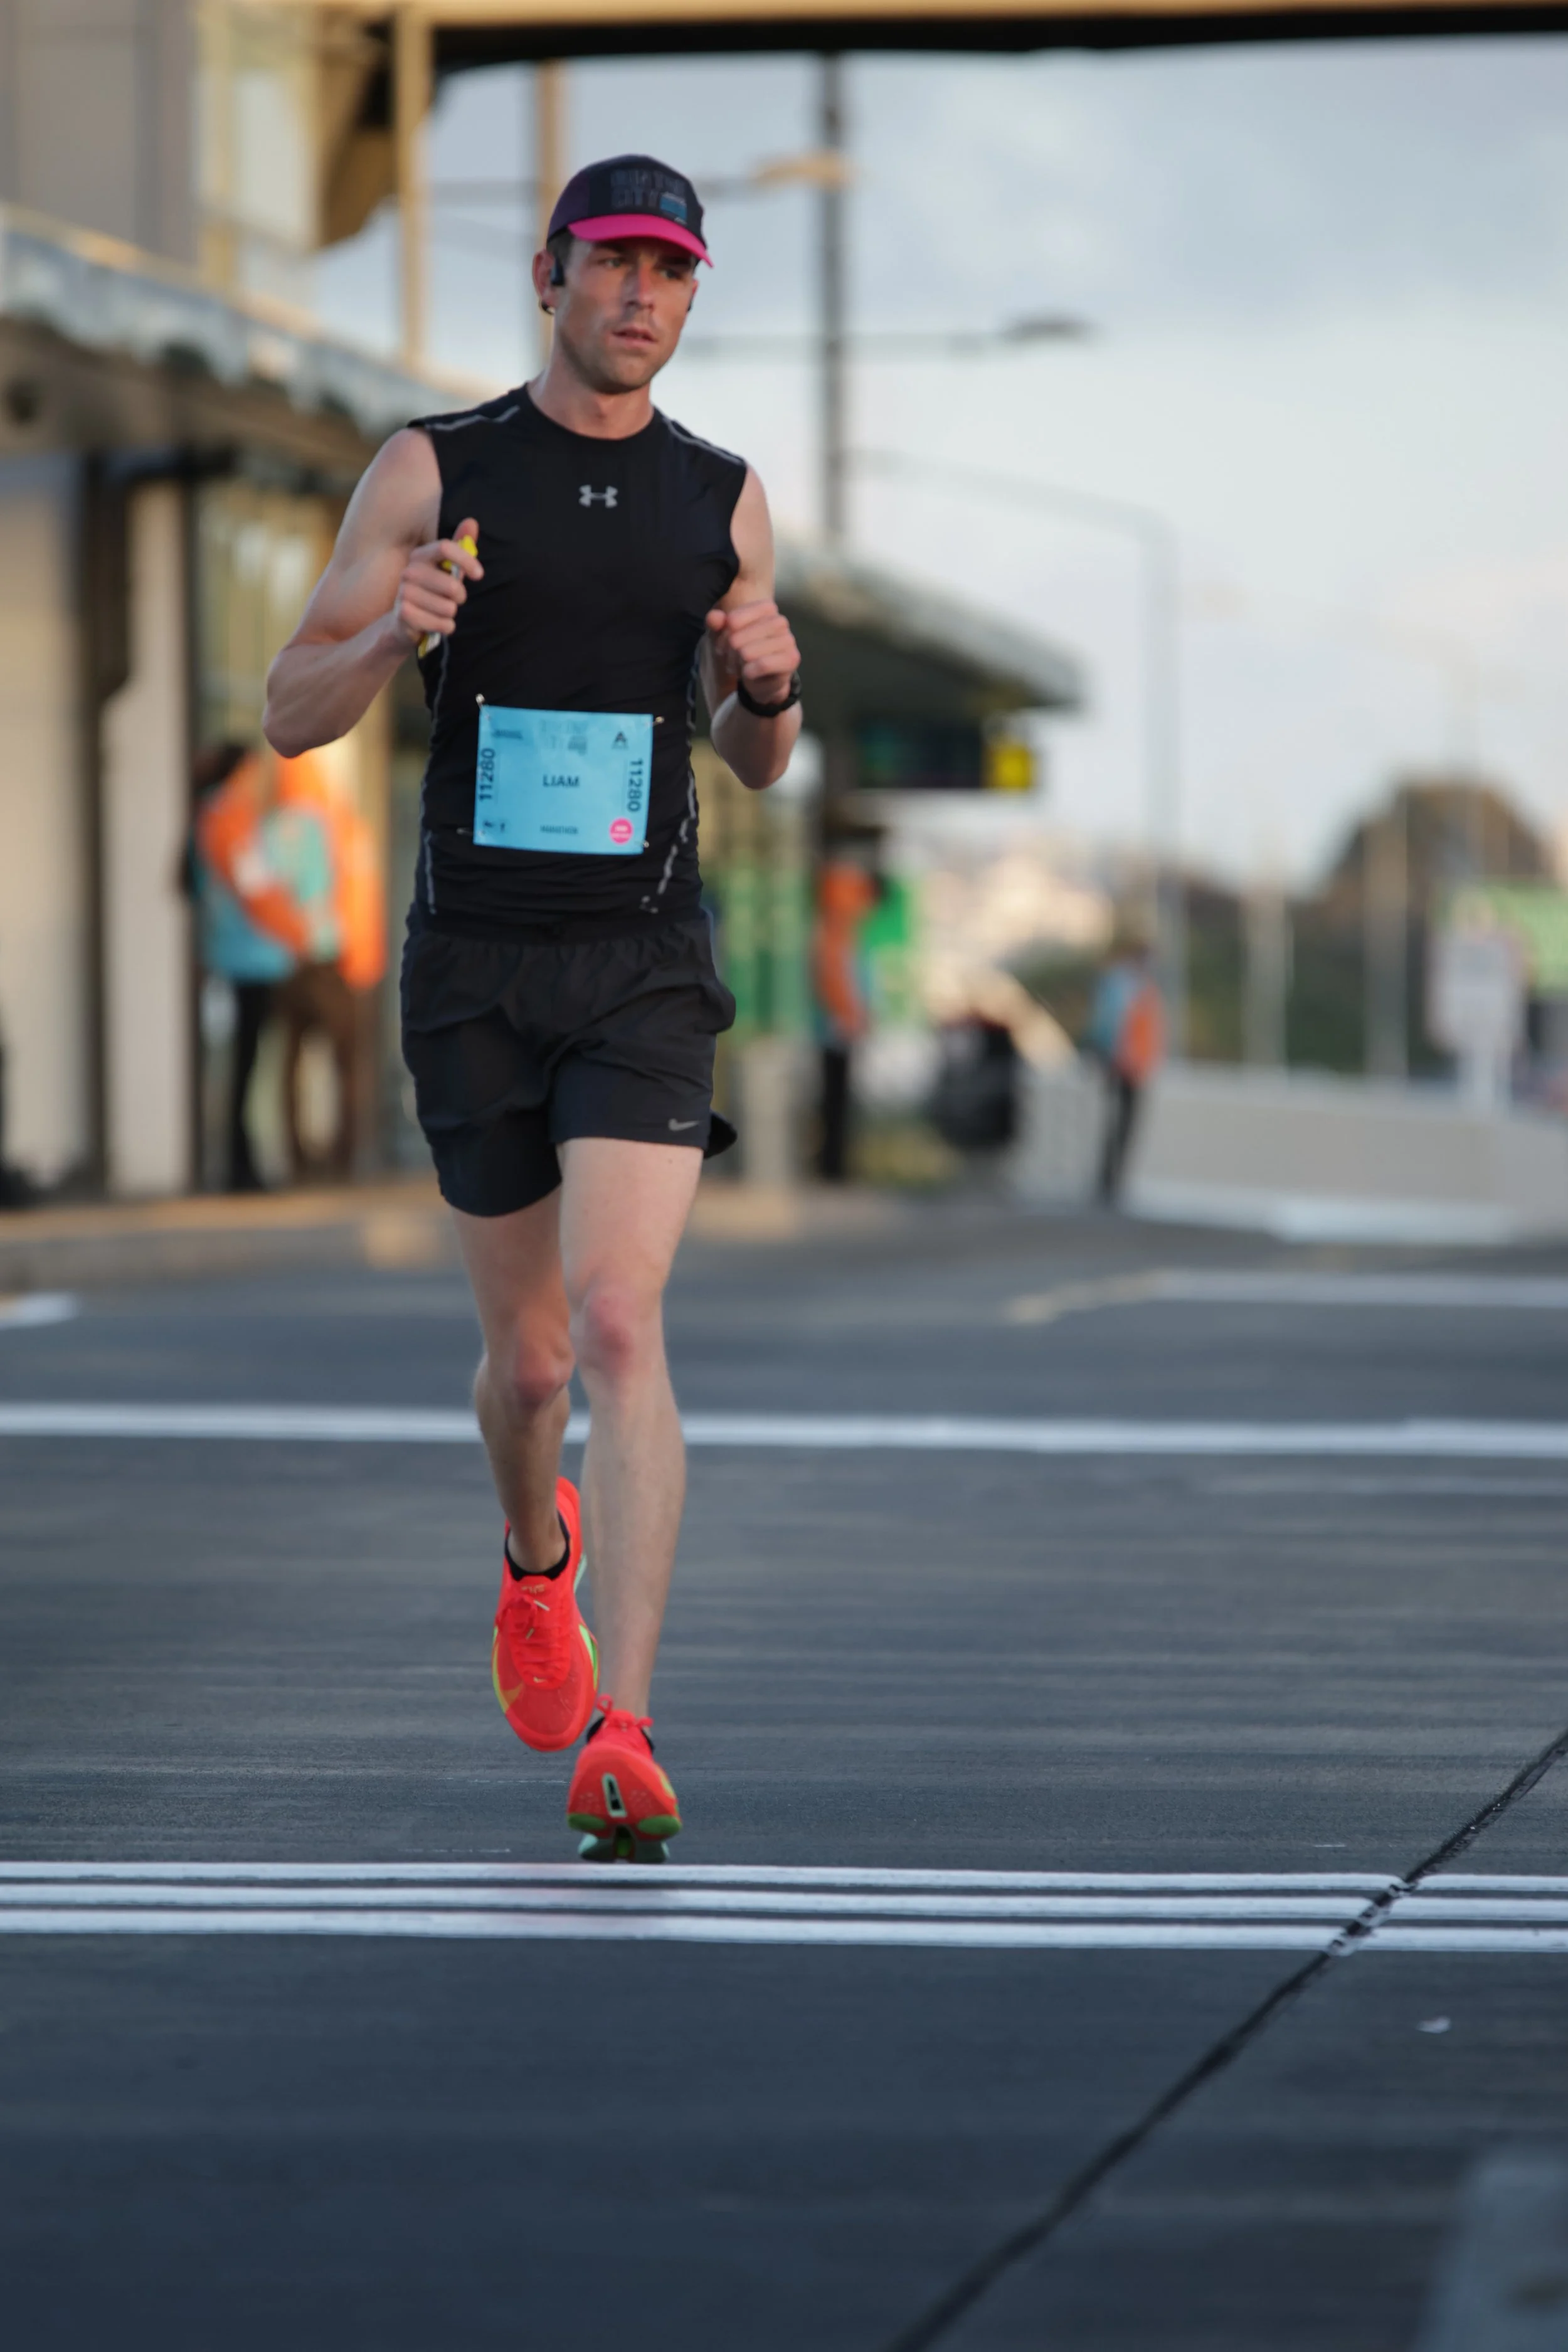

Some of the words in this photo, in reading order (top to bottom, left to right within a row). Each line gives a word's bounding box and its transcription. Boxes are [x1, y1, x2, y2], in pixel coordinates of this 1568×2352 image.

[614, 731, 627, 744] A
[479, 748, 495, 802] 11280
[543, 775, 580, 787] LIAM
[627, 758, 643, 812] 11280
